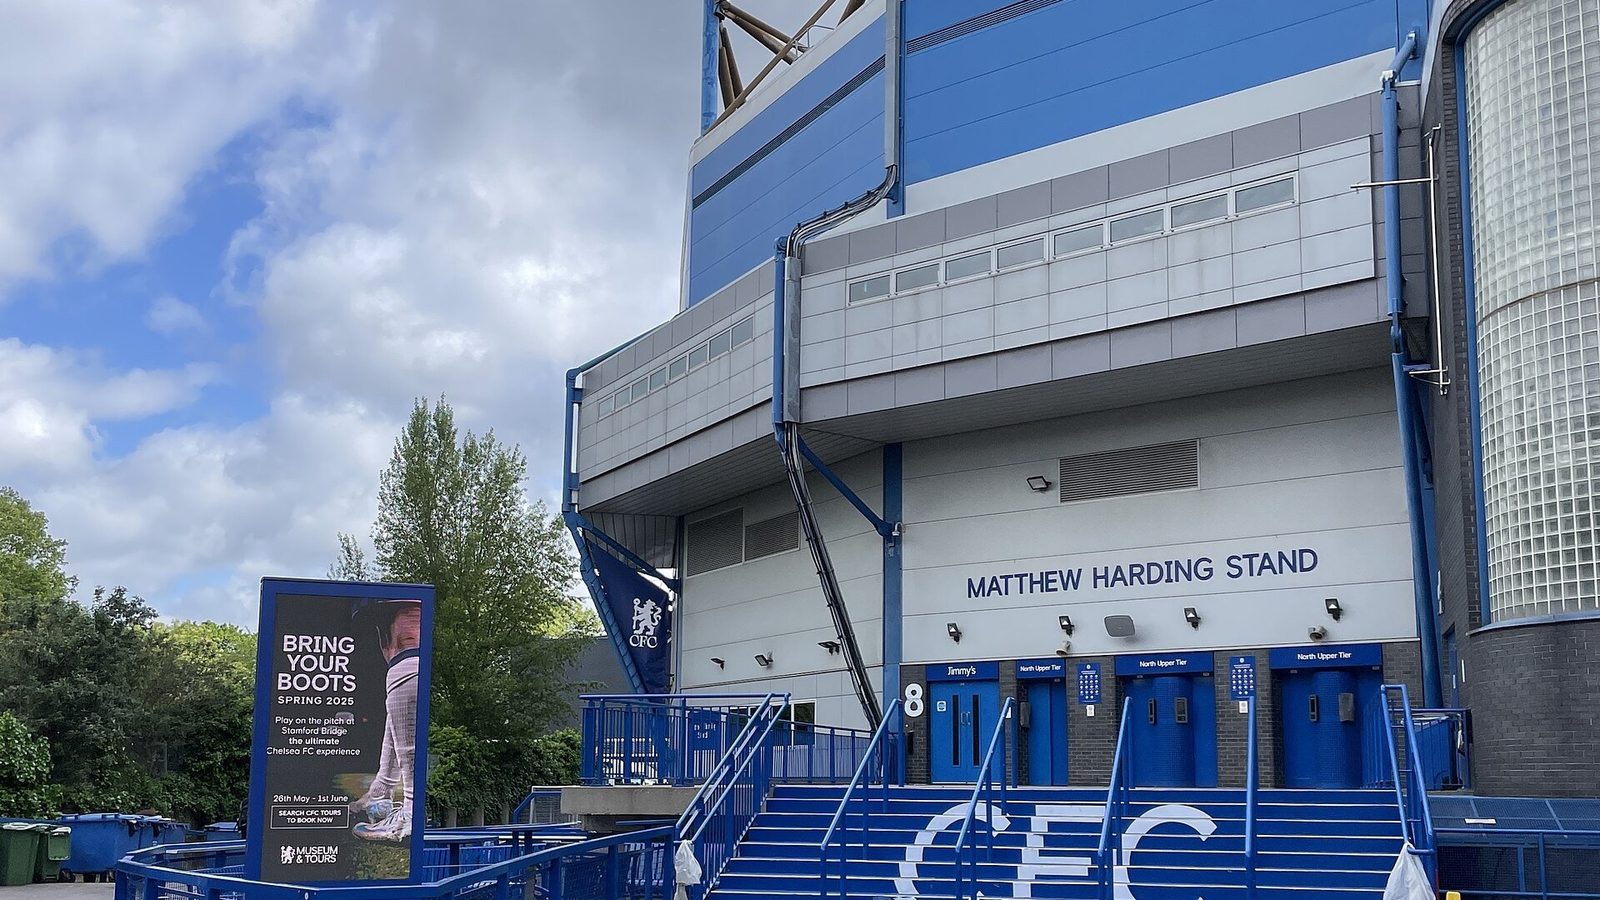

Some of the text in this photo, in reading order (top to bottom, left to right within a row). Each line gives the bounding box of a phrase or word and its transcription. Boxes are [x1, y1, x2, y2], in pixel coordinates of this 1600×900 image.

[967, 548, 1319, 598] MATTHEW HARDING STAND
[283, 634, 355, 654] BRING
[629, 634, 658, 648] CFC
[1317, 652, 1338, 661] Upper
[1338, 651, 1352, 659] Tier
[287, 654, 349, 672] YOUR
[1175, 658, 1187, 666] Tier
[947, 665, 977, 677] Jimmy's
[277, 673, 357, 692] BOOTS
[277, 696, 354, 706] SPRING 2025
[904, 683, 924, 717] 8
[275, 716, 294, 726] Play
[323, 717, 344, 726] pitch
[346, 717, 355, 725] at
[281, 726, 348, 736] Stamford Bridge
[289, 737, 340, 745] the ultimate
[266, 747, 361, 757] Chelsea FC experience
[273, 794, 292, 803] 26th
[293, 795, 310, 803] May
[330, 794, 349, 802] June
[296, 846, 339, 855] MUSEUM
[893, 802, 1218, 900] CFC
[296, 854, 337, 863] & TOURS
